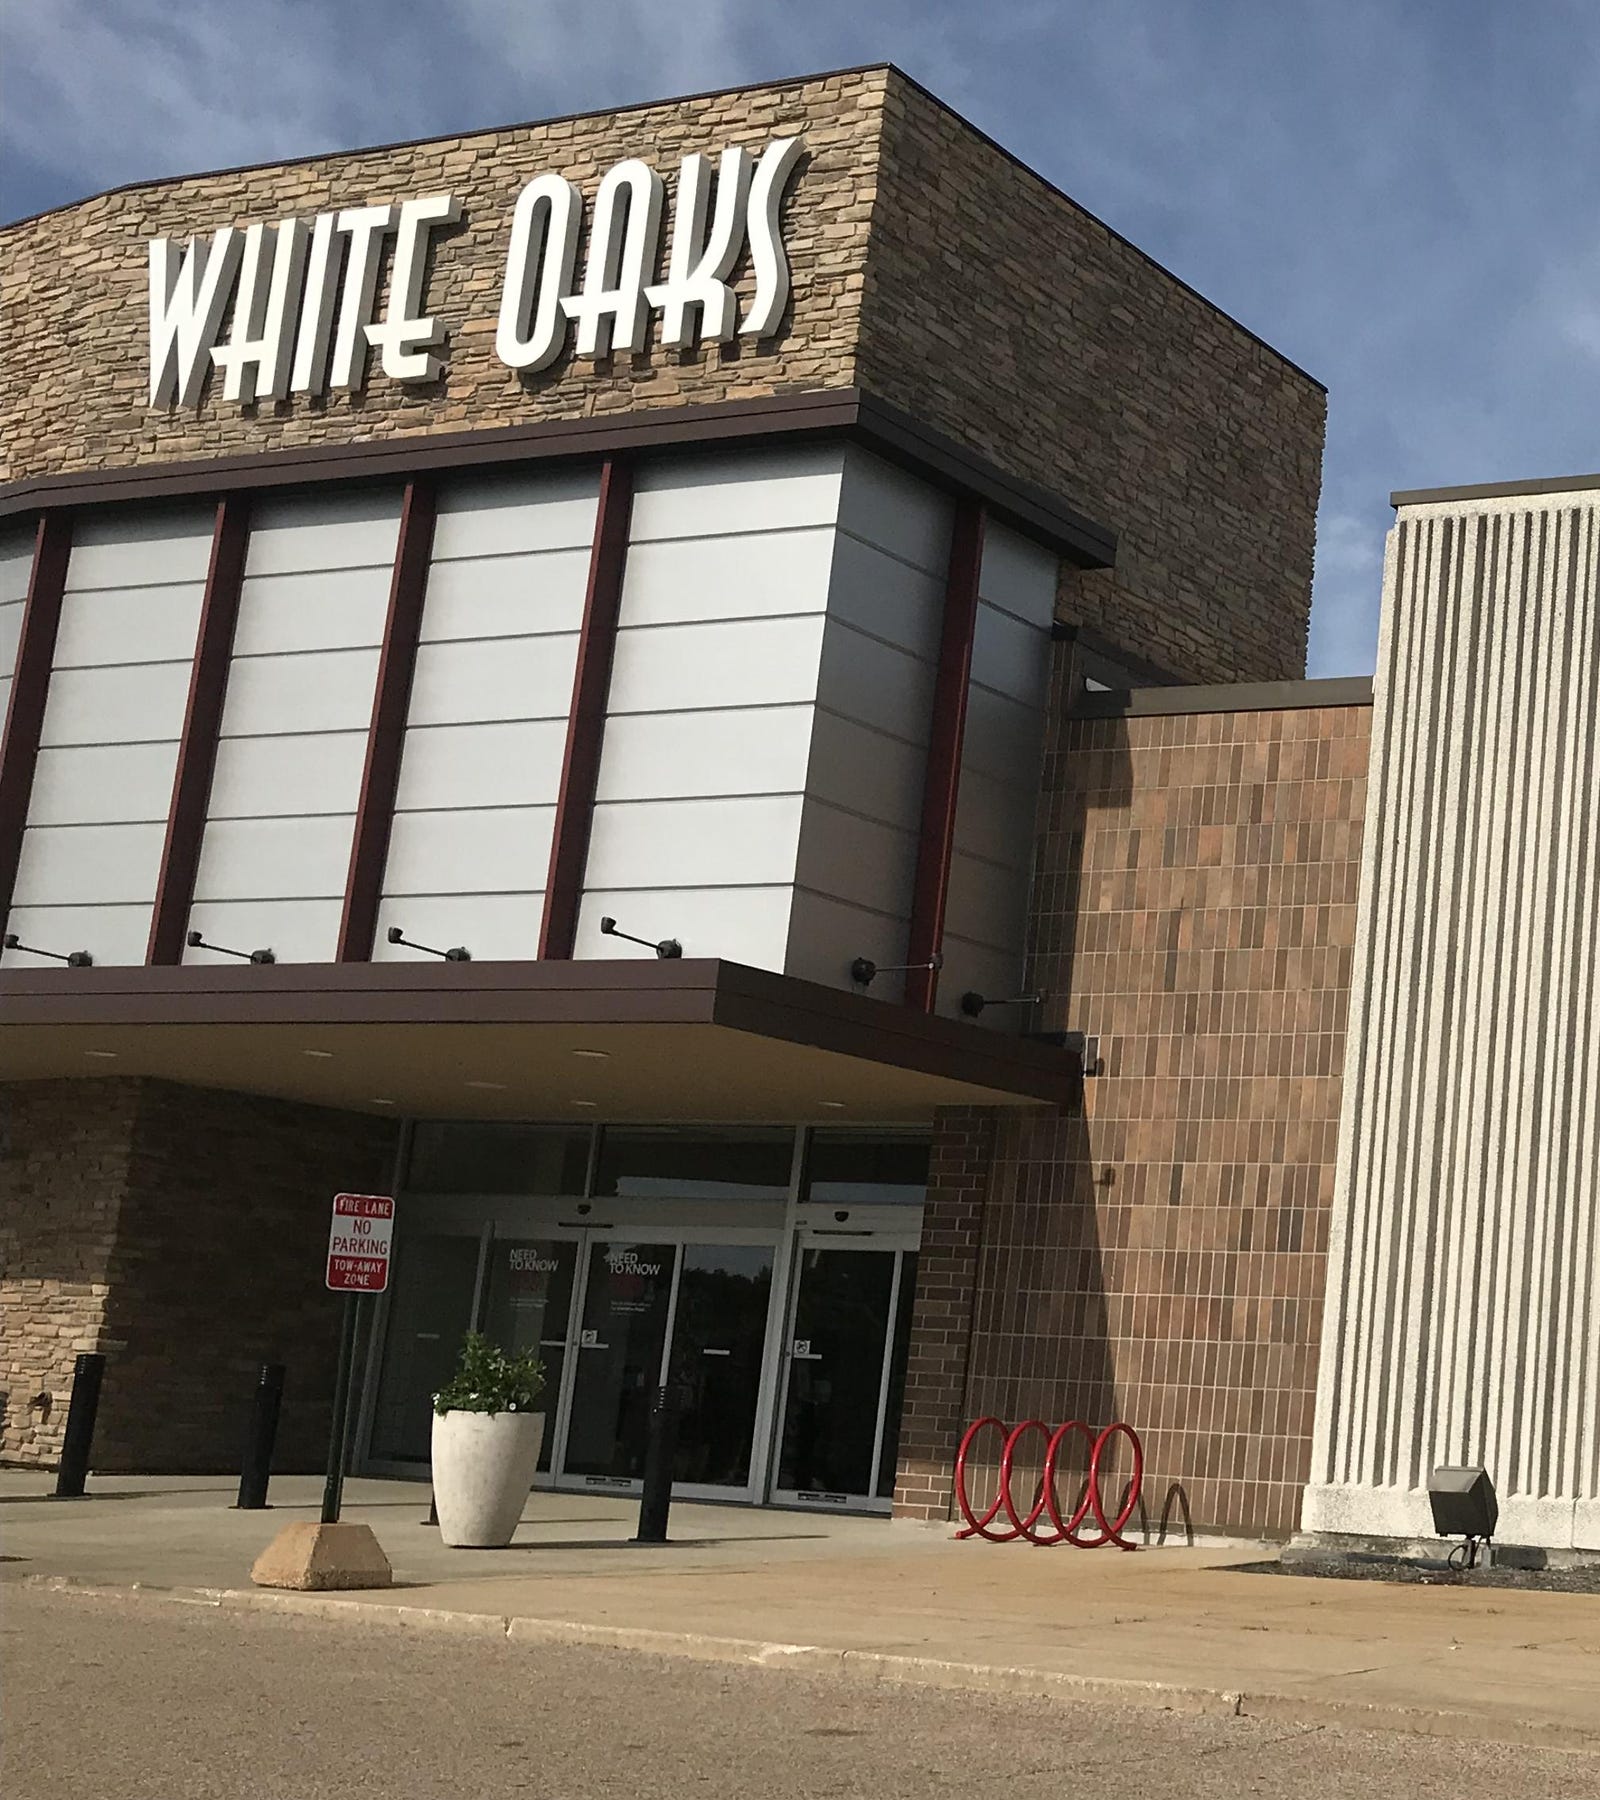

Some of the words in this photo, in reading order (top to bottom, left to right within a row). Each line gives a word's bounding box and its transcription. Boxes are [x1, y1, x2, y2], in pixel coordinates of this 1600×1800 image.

[149, 194, 457, 411] WHITE
[495, 136, 804, 370] OAKS
[340, 1197, 359, 1213] FIRE
[365, 1200, 390, 1216] LANE
[353, 1219, 371, 1235] NO
[332, 1236, 388, 1255] PARKING
[510, 1249, 537, 1260] NEED
[610, 1251, 638, 1264] NEED
[334, 1258, 383, 1273] TOW-AWAY
[510, 1259, 523, 1271] TO
[525, 1259, 559, 1271] KNOW
[610, 1263, 624, 1274] TO
[625, 1263, 661, 1275] KNOW
[344, 1273, 370, 1286] ZONE
